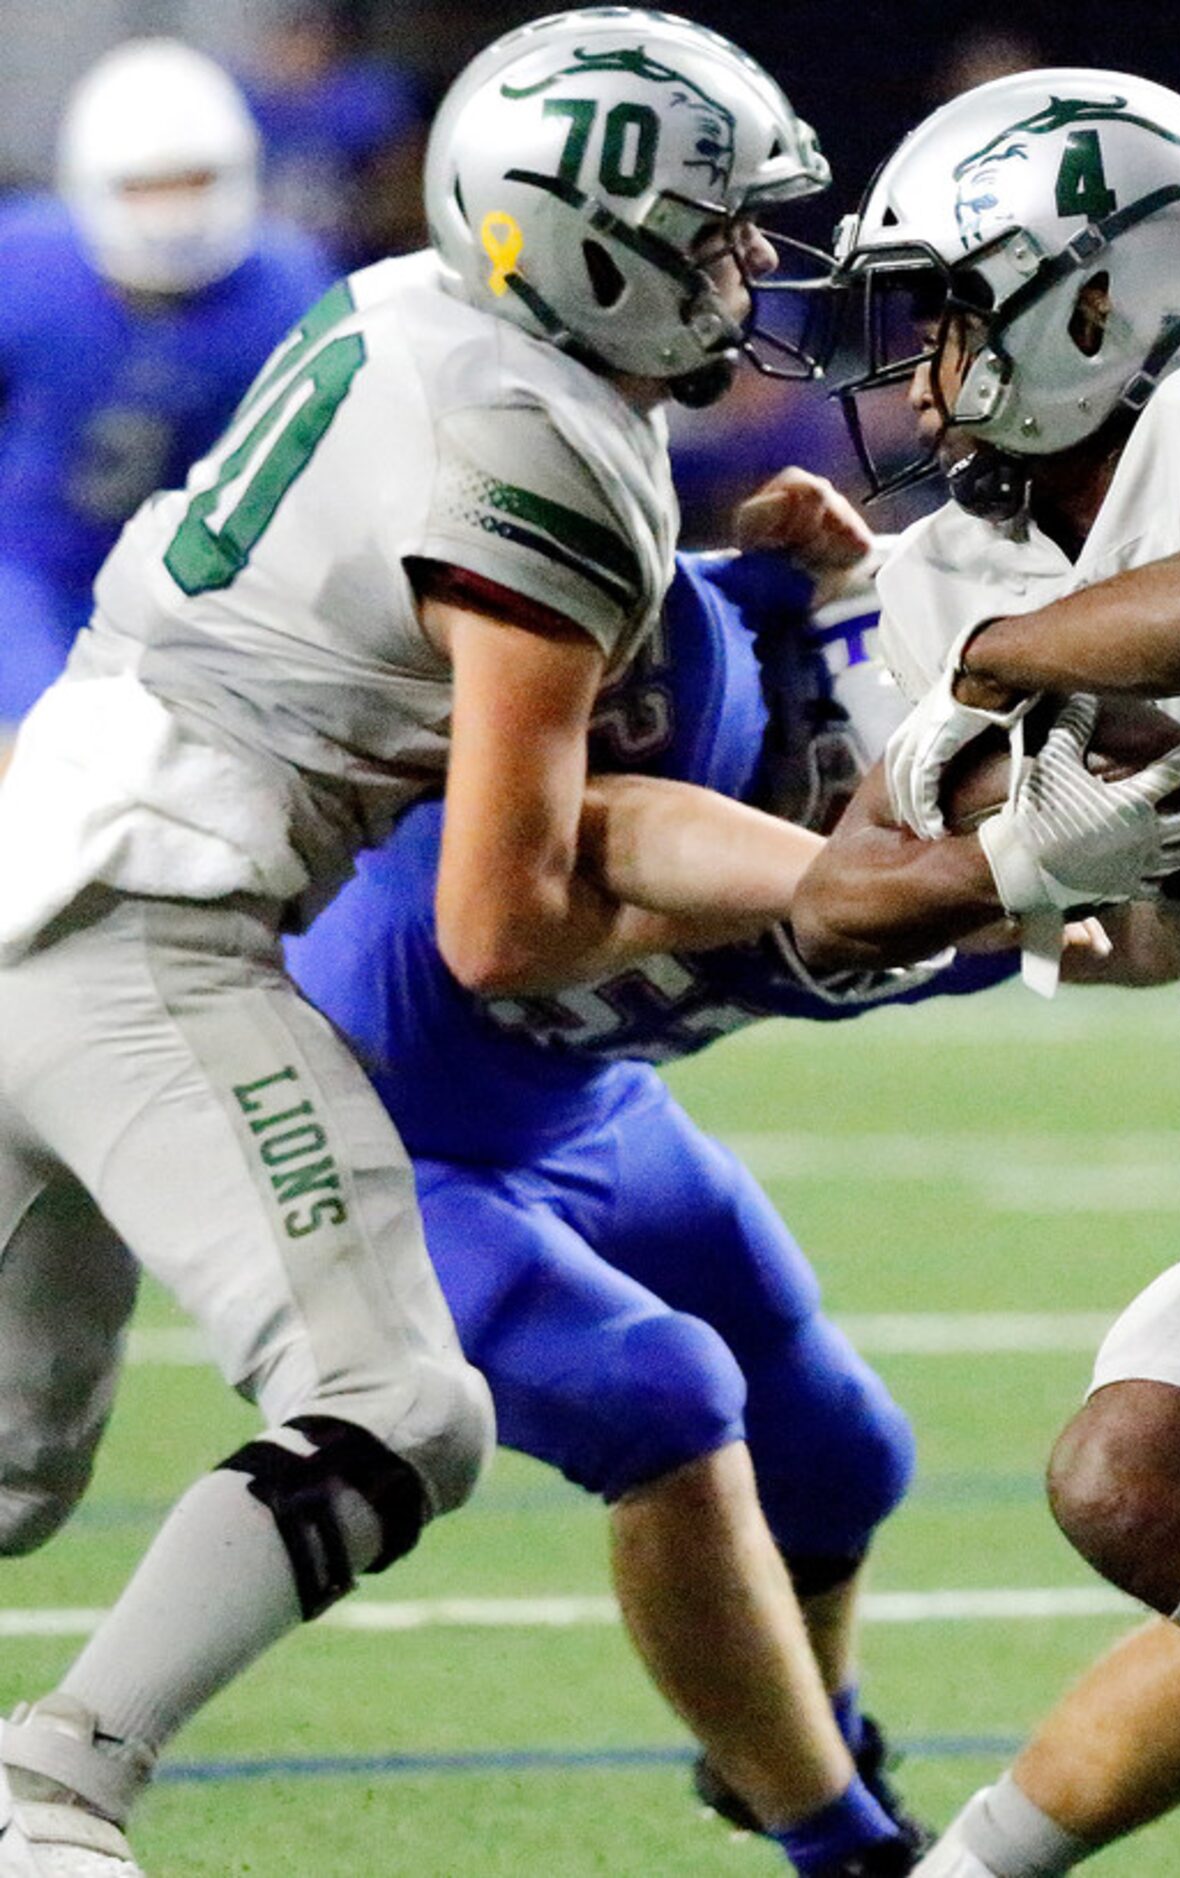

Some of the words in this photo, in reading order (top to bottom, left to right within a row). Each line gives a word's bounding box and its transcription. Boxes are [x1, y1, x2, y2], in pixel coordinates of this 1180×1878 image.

[541, 98, 661, 198] 70
[1055, 128, 1118, 224] 4
[232, 1065, 348, 1239] LIONS
